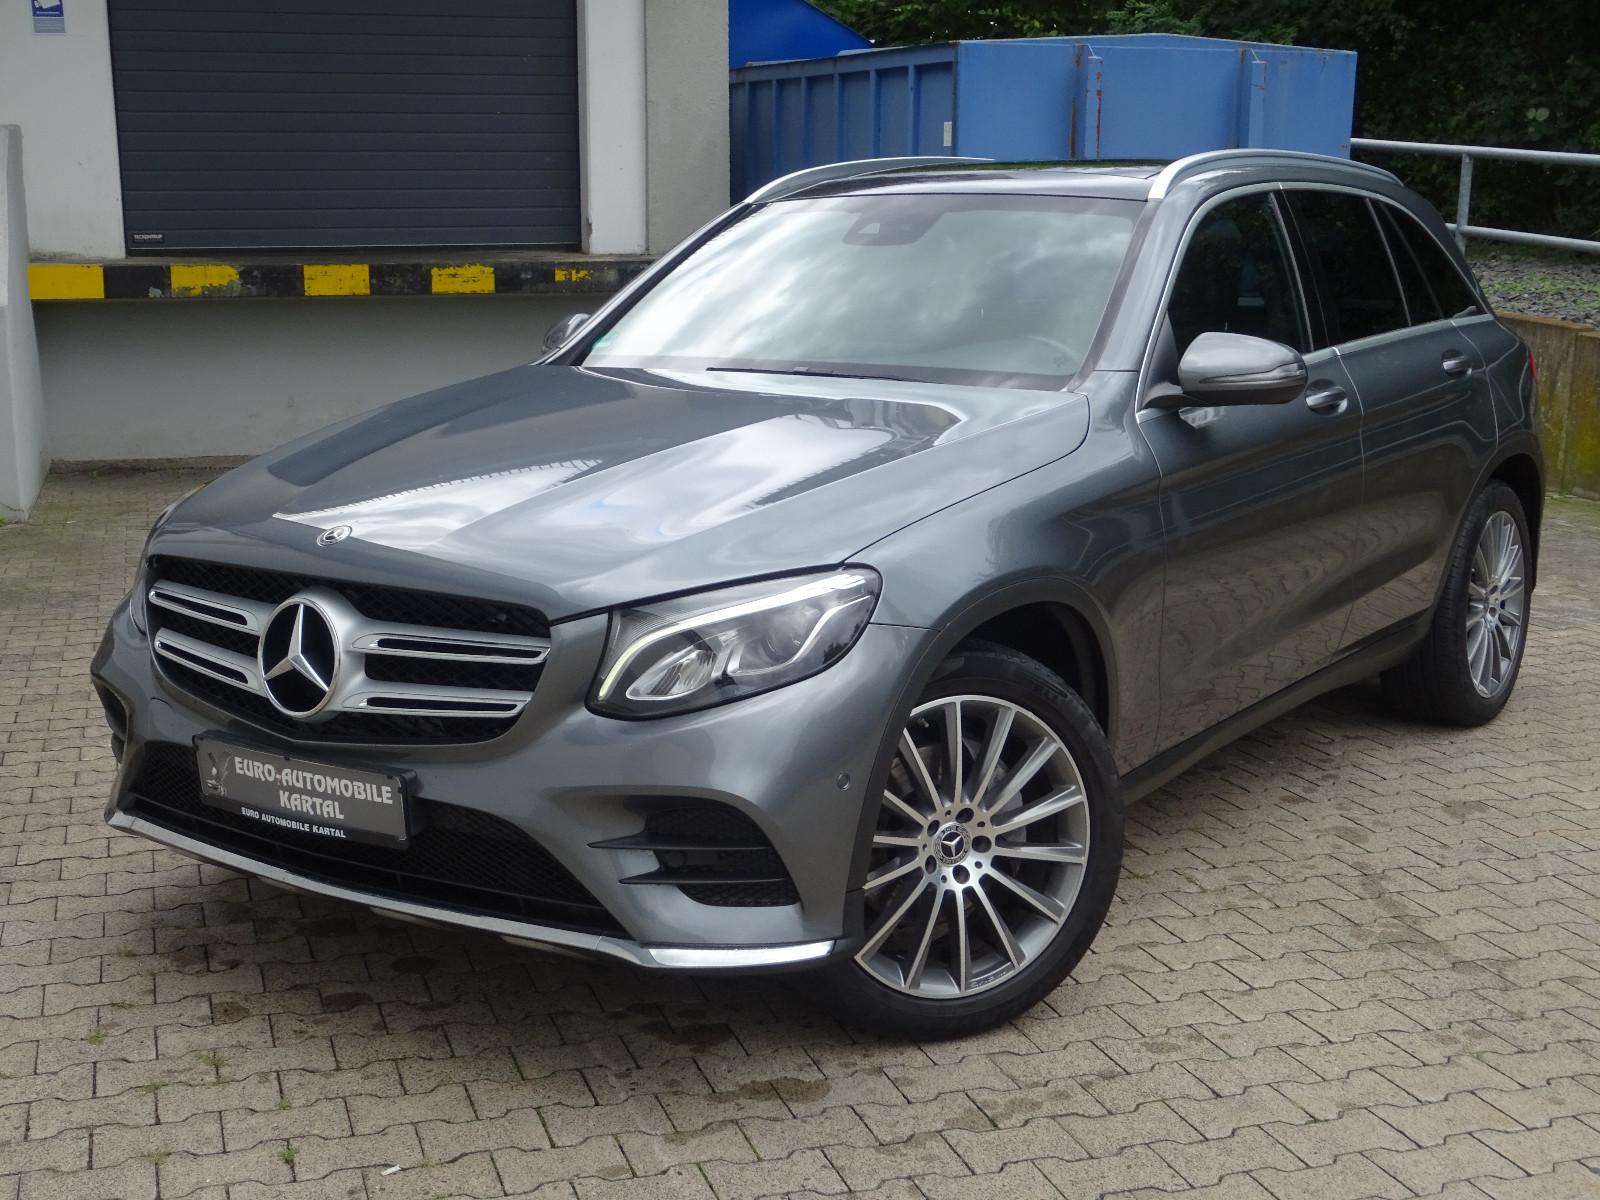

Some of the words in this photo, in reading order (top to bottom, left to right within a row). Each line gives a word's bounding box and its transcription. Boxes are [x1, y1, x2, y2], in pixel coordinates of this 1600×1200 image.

[234, 756, 393, 804] EURO-AUTOMOBILE
[279, 790, 344, 819] KARTAL
[241, 807, 260, 819] EURO
[261, 813, 310, 831] AUTOMOBILE
[312, 825, 346, 838] KARTAL
